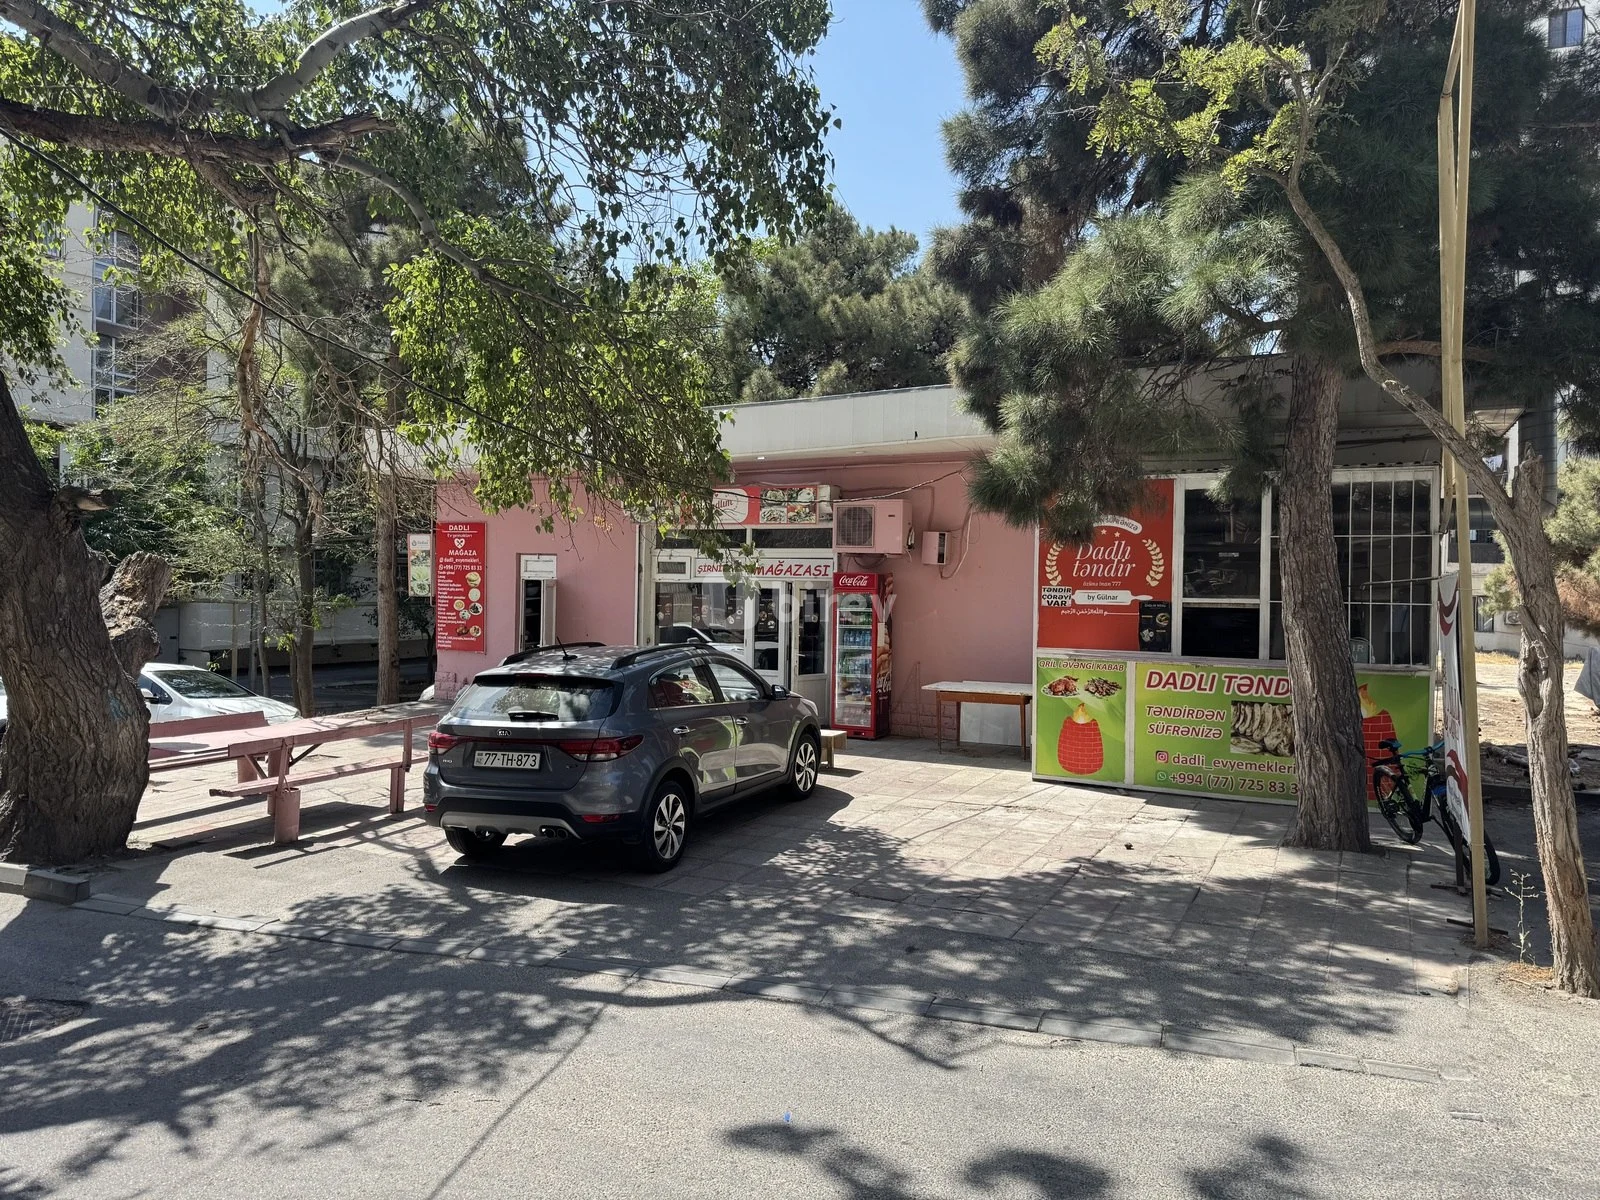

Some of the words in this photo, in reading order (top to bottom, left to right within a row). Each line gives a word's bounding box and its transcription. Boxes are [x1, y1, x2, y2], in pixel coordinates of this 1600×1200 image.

[1075, 541, 1131, 560] Dadlı
[1072, 559, 1136, 577] təndir
[1096, 593, 1119, 601] Gülnar
[1096, 663, 1124, 671] KABAB
[1146, 671, 1217, 692] DADLI
[1222, 675, 1292, 696] TƏND
[1146, 705, 1226, 721] TƏNDİRDƏN
[1147, 723, 1223, 739] SÜFRƏNİZƏ
[1169, 772, 1203, 785] +994
[1207, 775, 1234, 791] (77)
[1239, 778, 1264, 791] 725
[1268, 781, 1286, 793] 83
[1289, 783, 1299, 795] 3
